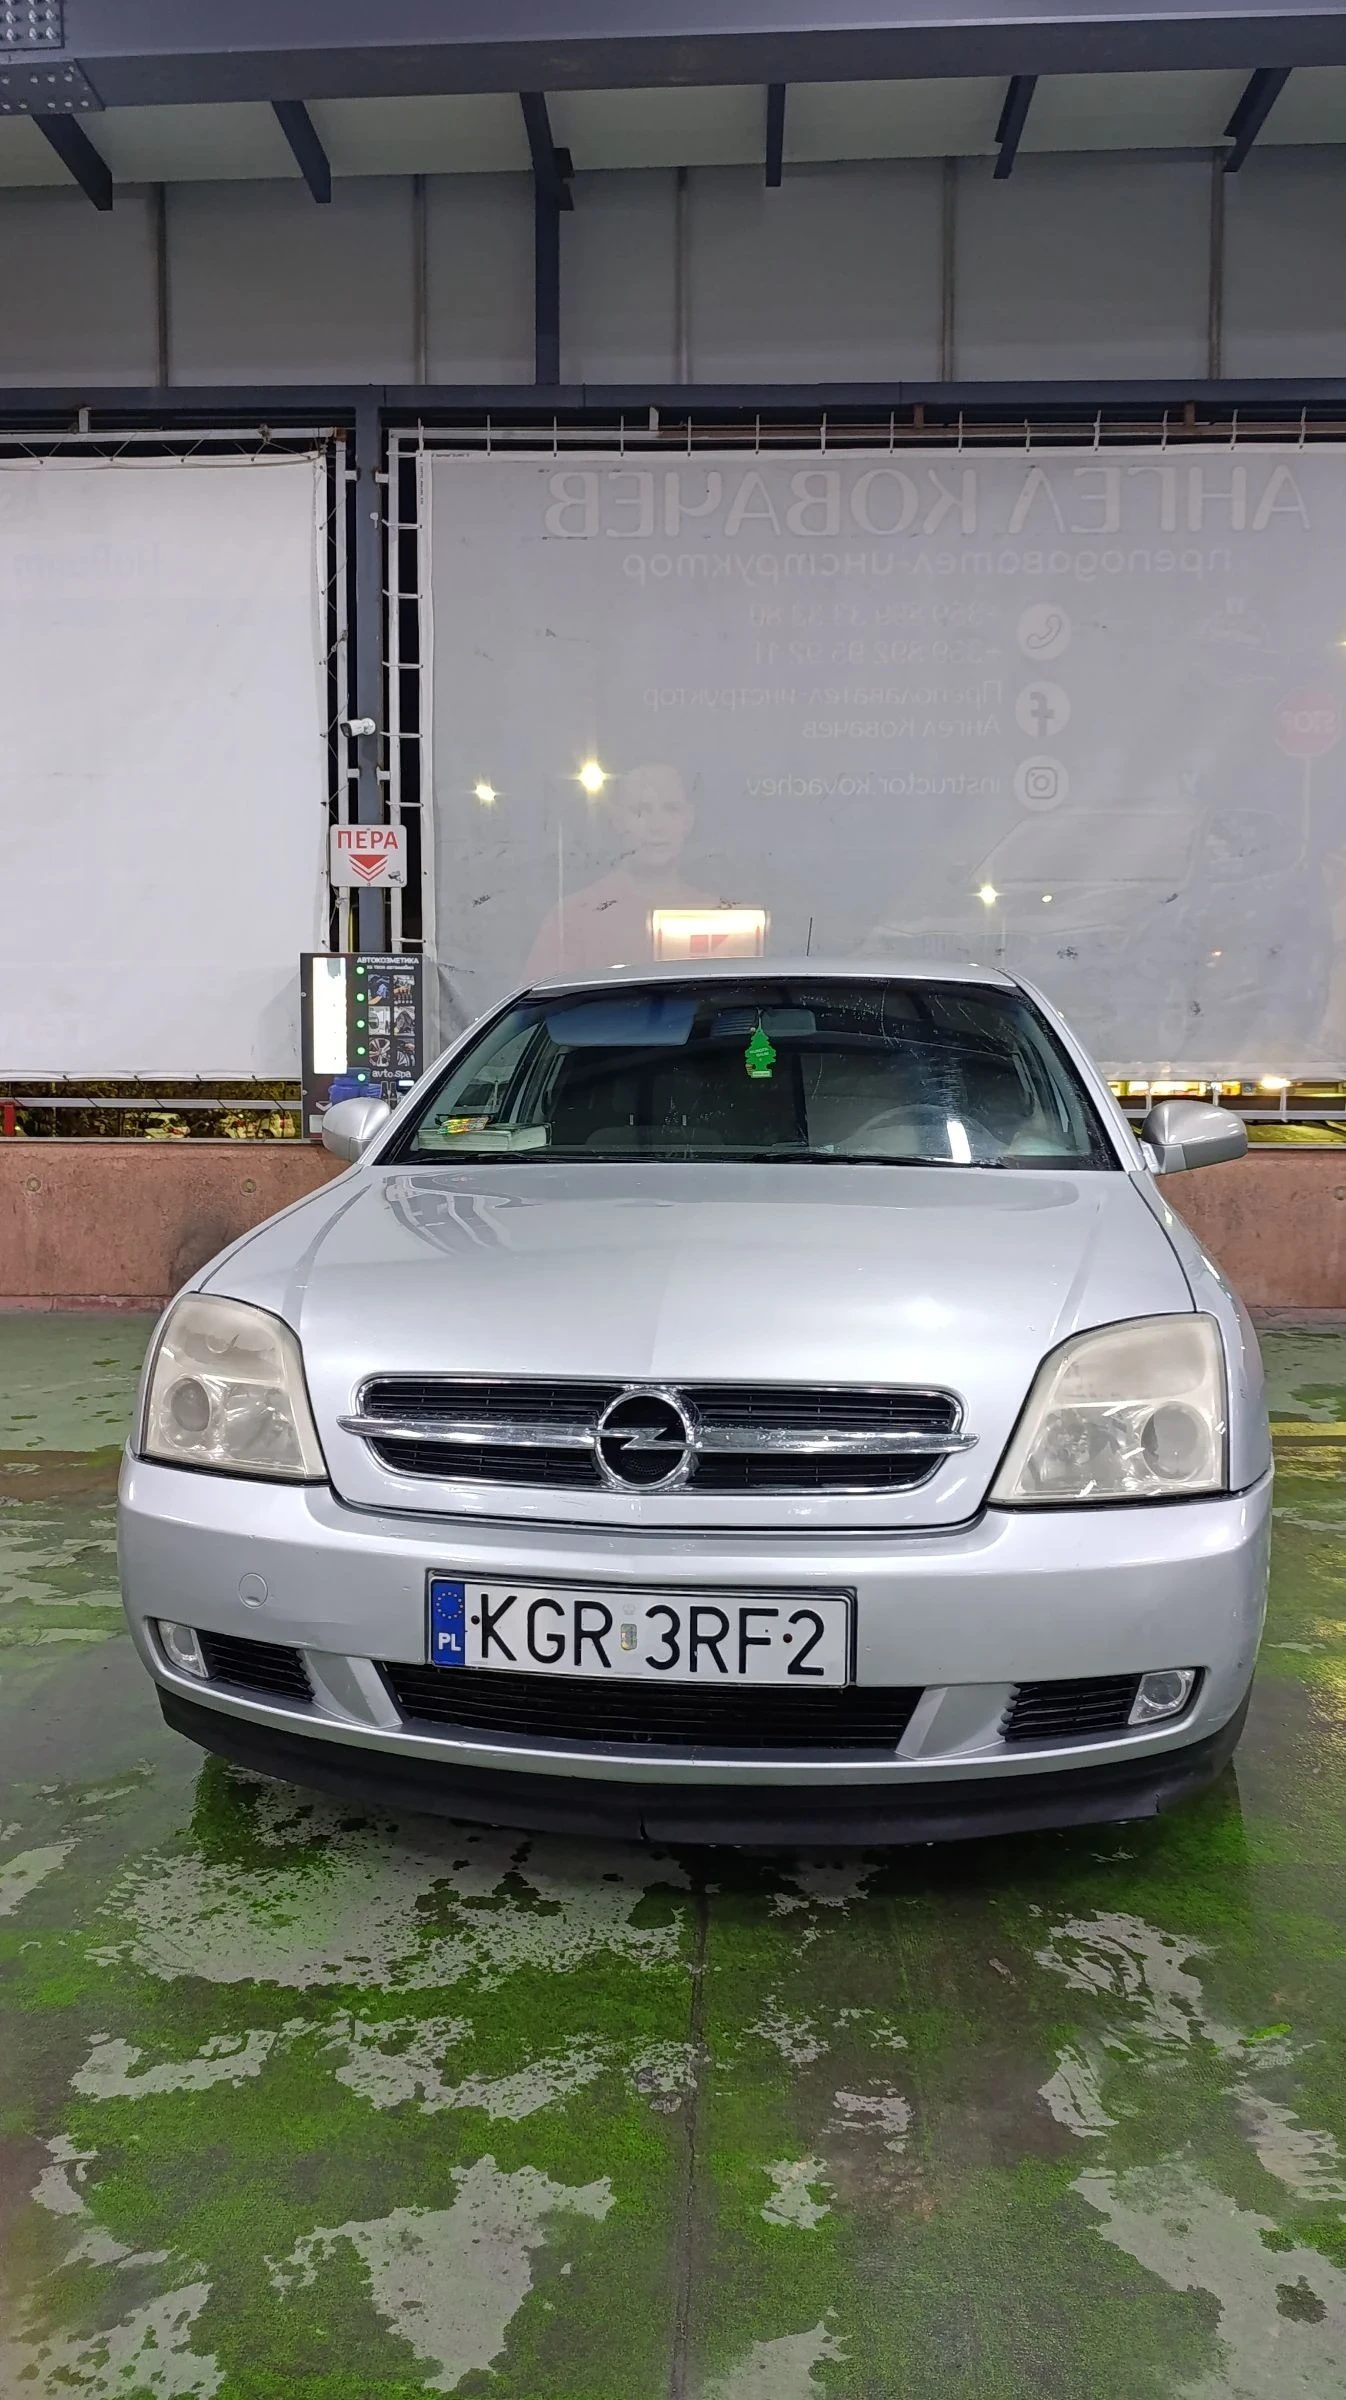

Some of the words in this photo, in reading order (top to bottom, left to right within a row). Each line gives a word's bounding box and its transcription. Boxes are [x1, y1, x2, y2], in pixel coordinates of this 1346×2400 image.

[337, 830, 399, 850] ПЕРА
[356, 956, 420, 965] АВТОКОЗМЕТИКА
[437, 1632, 462, 1652] PL
[480, 1593, 613, 1668] KGR
[644, 1604, 825, 1676] 3RF2
